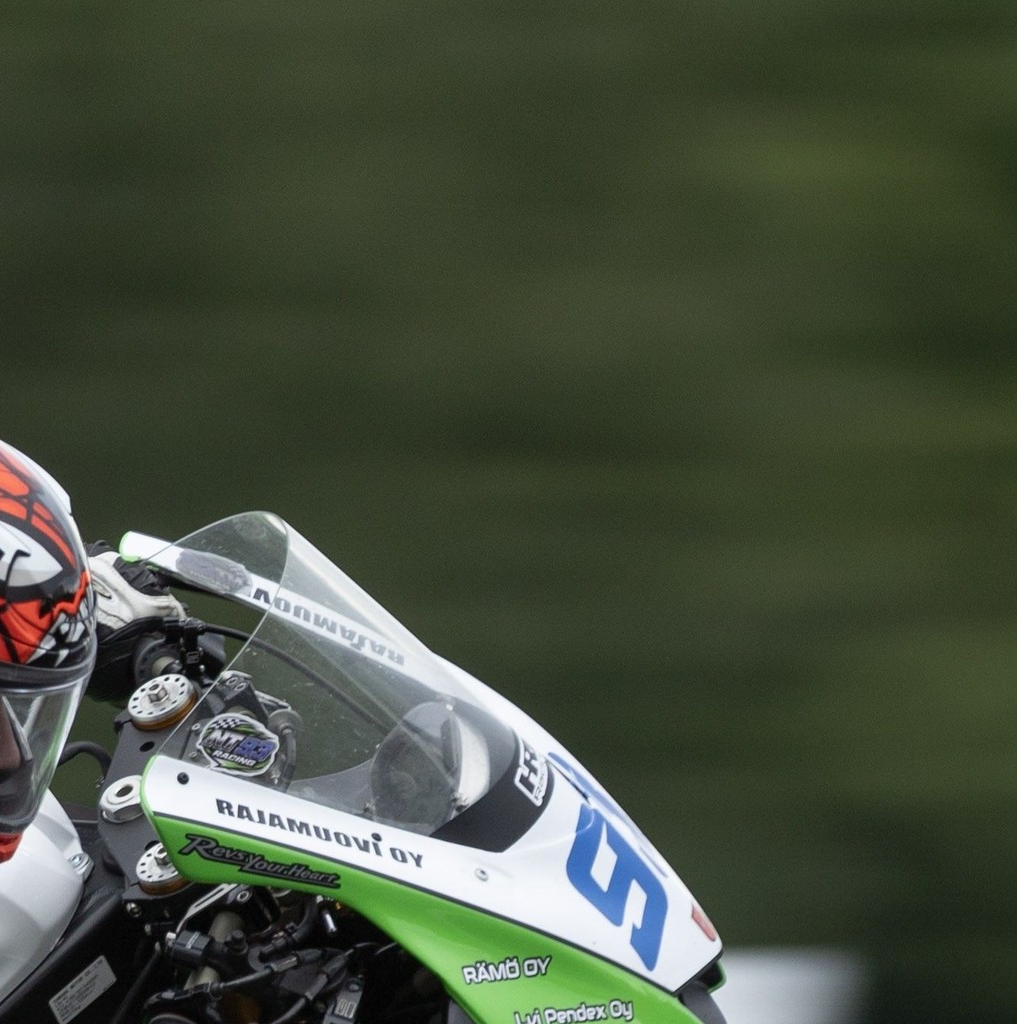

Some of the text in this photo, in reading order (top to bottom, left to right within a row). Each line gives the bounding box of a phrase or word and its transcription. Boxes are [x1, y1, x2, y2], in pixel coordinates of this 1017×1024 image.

[253, 588, 405, 666] RAJAMUOV
[212, 750, 257, 767] RACING
[390, 847, 424, 868] OY
[462, 956, 552, 985] RÄMÖ OY
[609, 1000, 634, 1022] Oy
